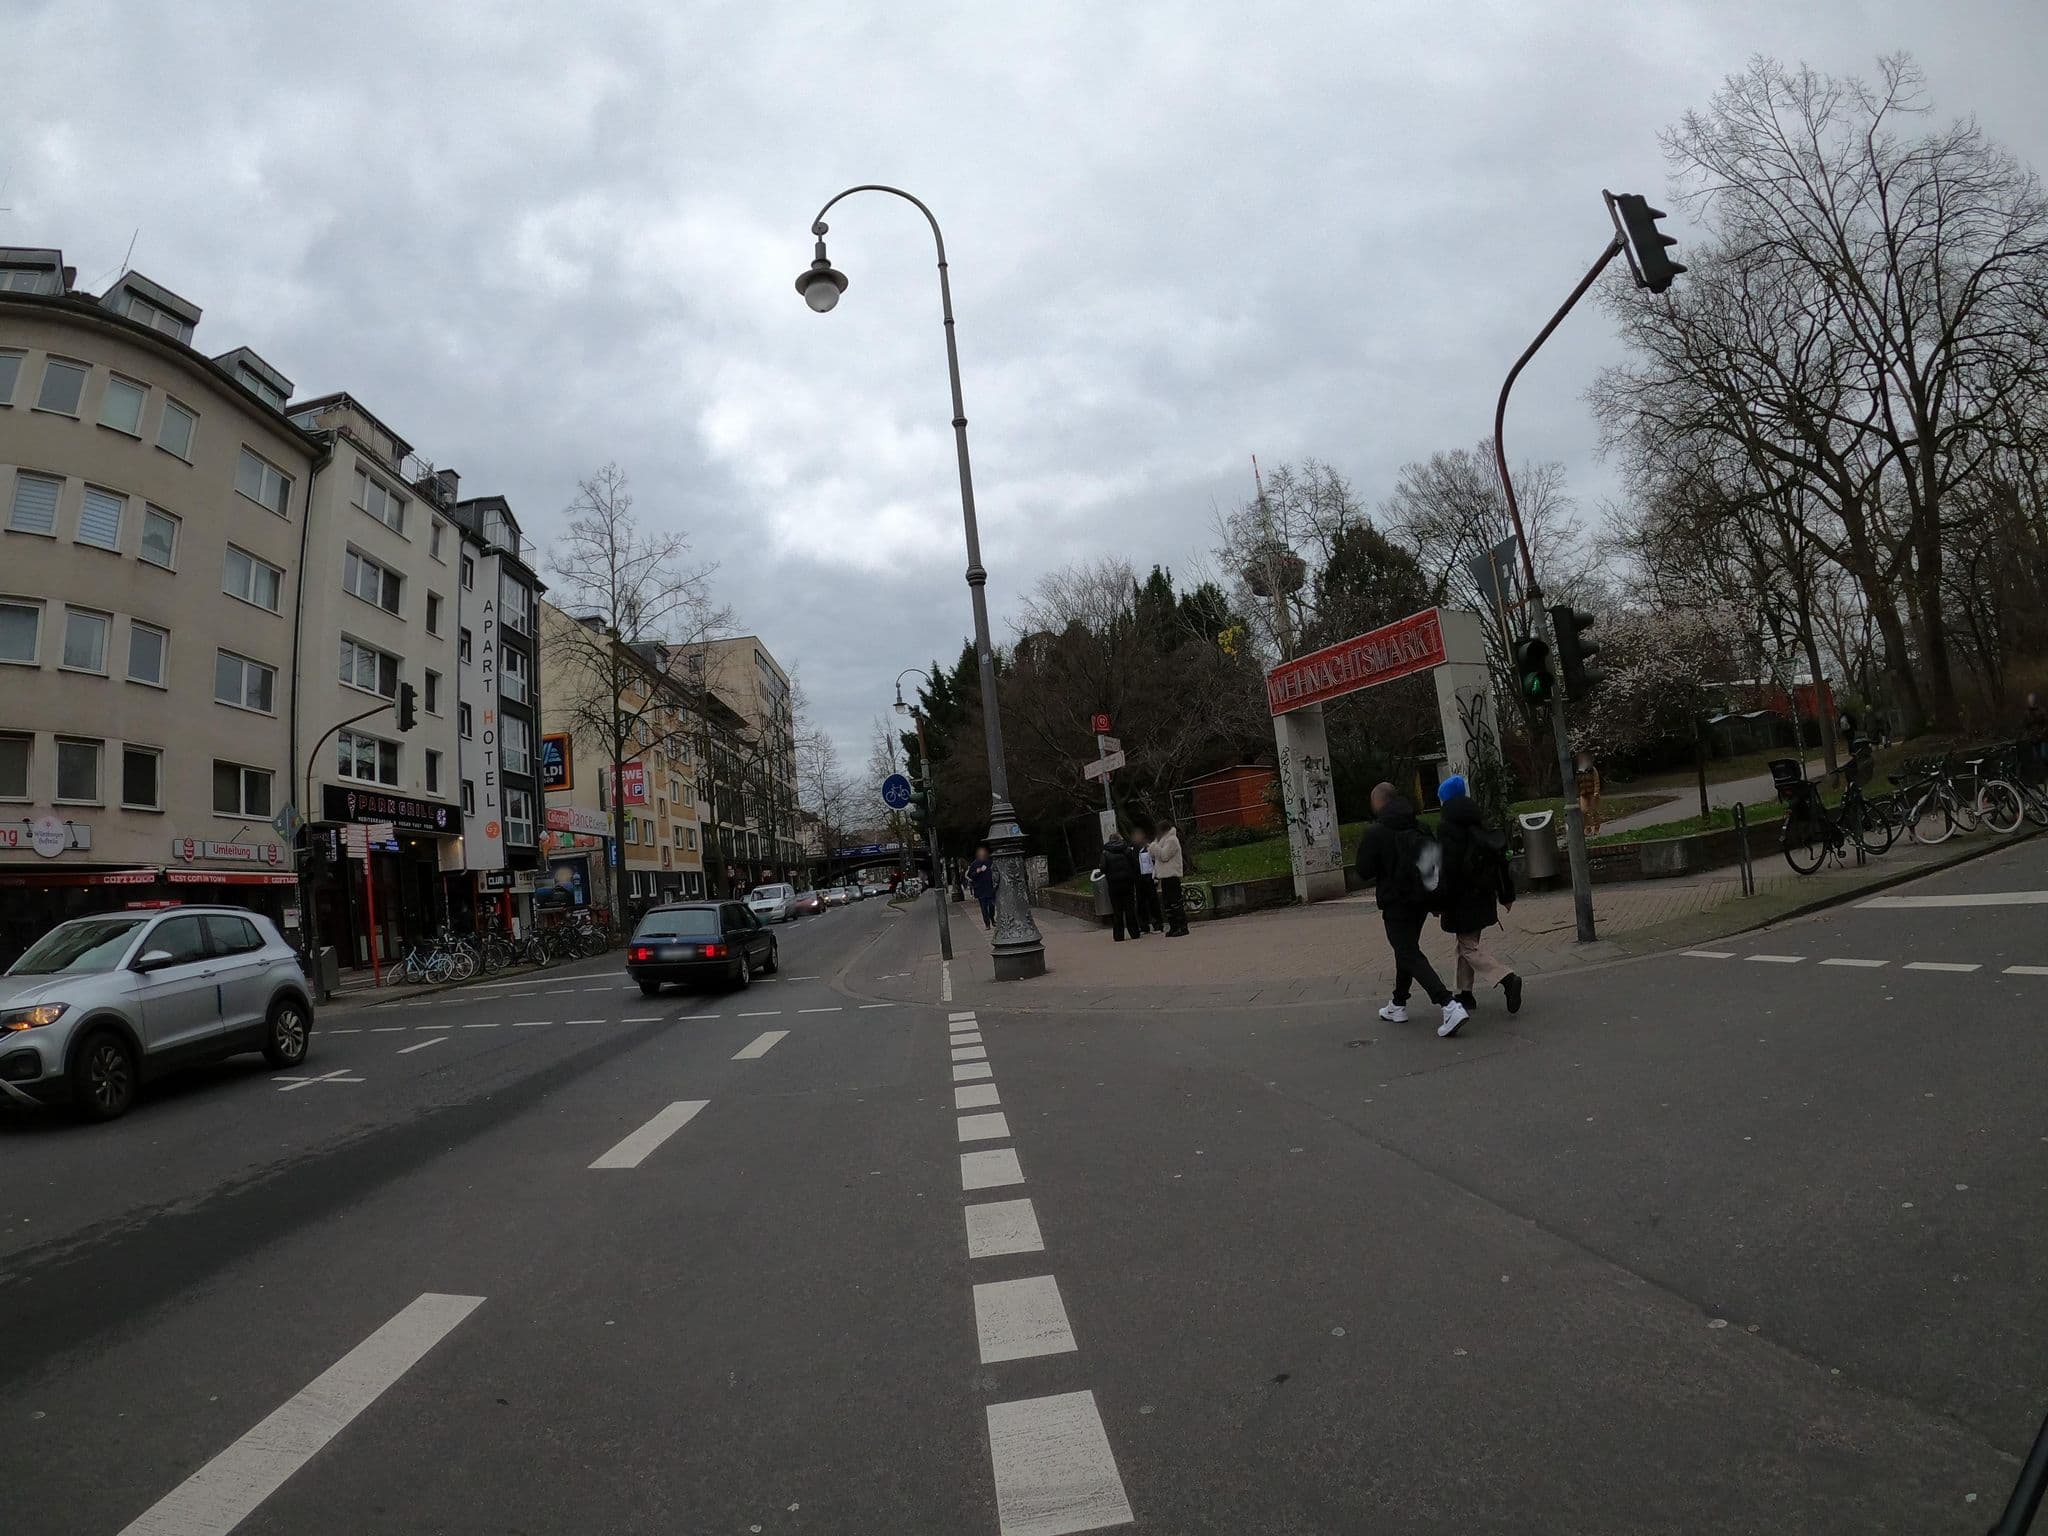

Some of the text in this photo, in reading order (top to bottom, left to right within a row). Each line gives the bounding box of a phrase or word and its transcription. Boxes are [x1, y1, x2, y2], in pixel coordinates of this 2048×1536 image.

[481, 600, 494, 693] APART
[1268, 619, 1441, 705] WEIHNACHTSMARKT
[483, 709, 496, 807] HOTEL
[543, 764, 563, 777] LDI
[358, 794, 435, 819] PARK GRILL
[568, 808, 593, 829] Dance
[213, 844, 251, 859] Umleitung
